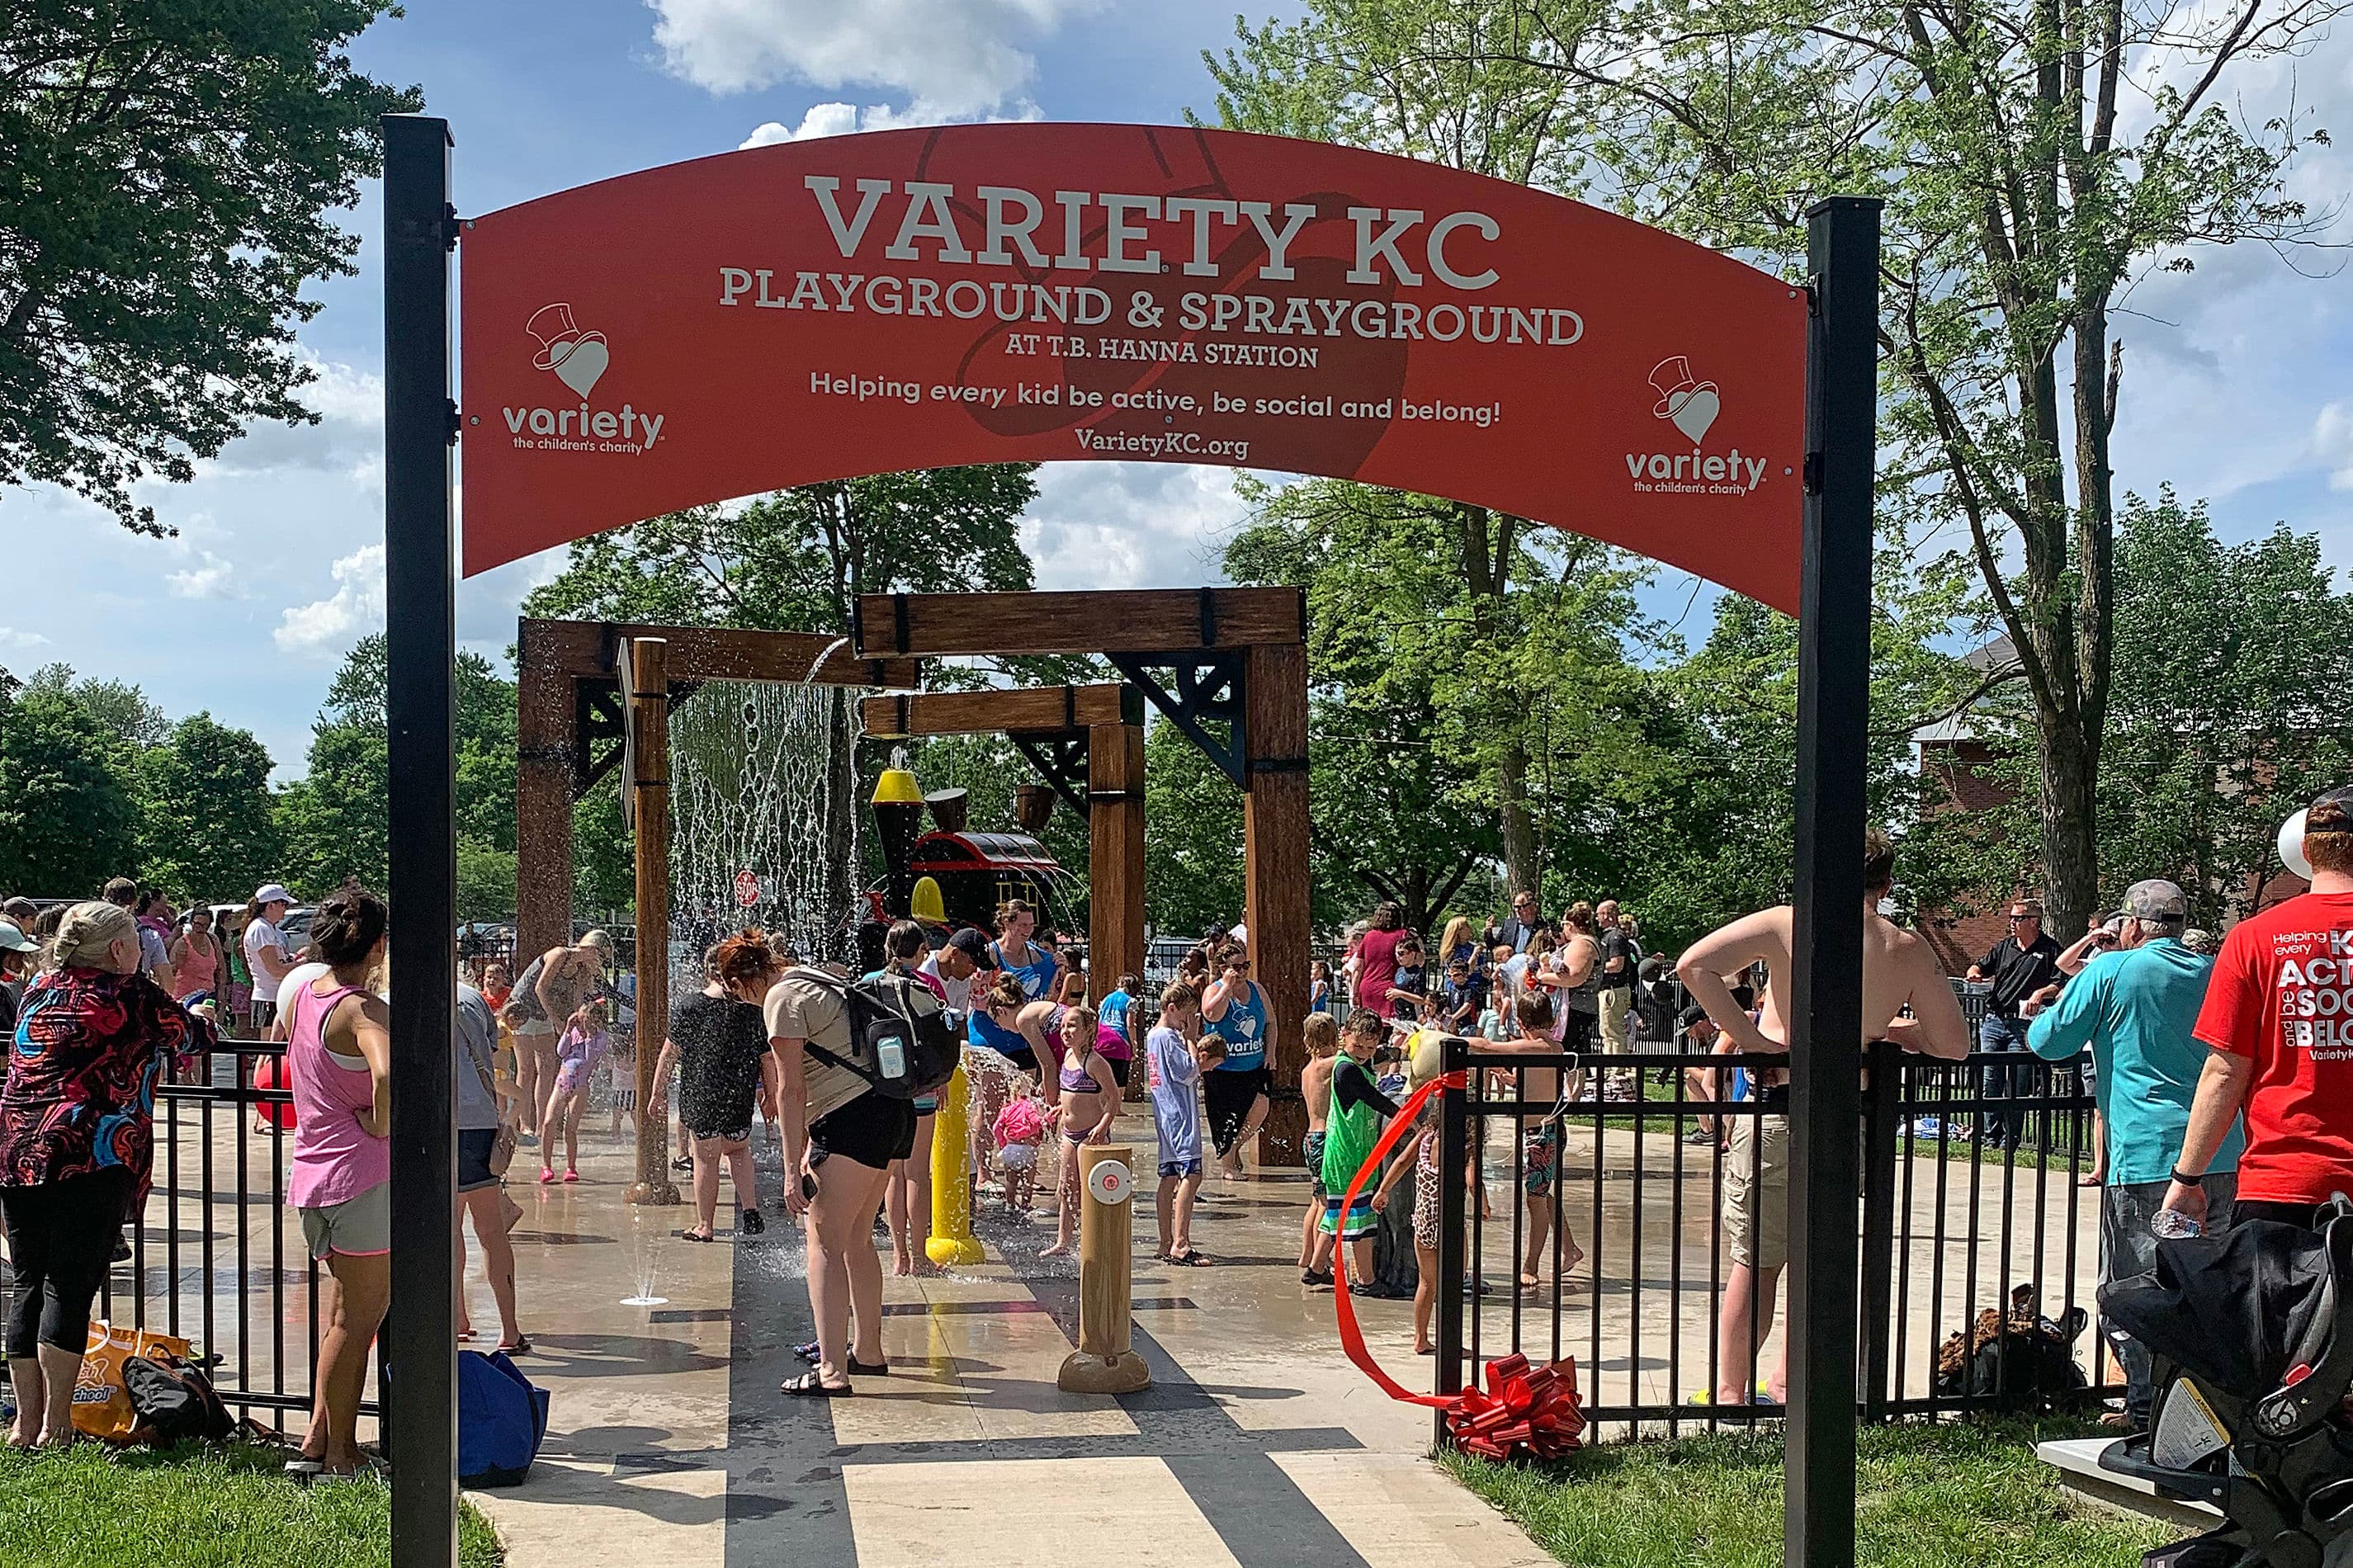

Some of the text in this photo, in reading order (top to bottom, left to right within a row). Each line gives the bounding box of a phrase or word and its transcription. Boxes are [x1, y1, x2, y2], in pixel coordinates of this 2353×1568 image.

[805, 176, 1500, 290] VARIETY KC
[720, 267, 1584, 345] PLAYGROUND & SPRAYGROUND
[1005, 333, 1319, 368] AT T.B. HANNA STATION
[811, 371, 1500, 428] Helping every kid be active, be social and belong!
[503, 402, 664, 451] variety
[513, 437, 643, 456] the children's charity
[1075, 428, 1250, 461] VarietyKC.org
[1625, 447, 1767, 491] variety
[1633, 481, 1747, 497] the children's charity
[2273, 930, 2327, 945] Helping
[2275, 943, 2312, 956] every
[1226, 1037, 1263, 1052] variet
[73, 1388, 109, 1401] chool
